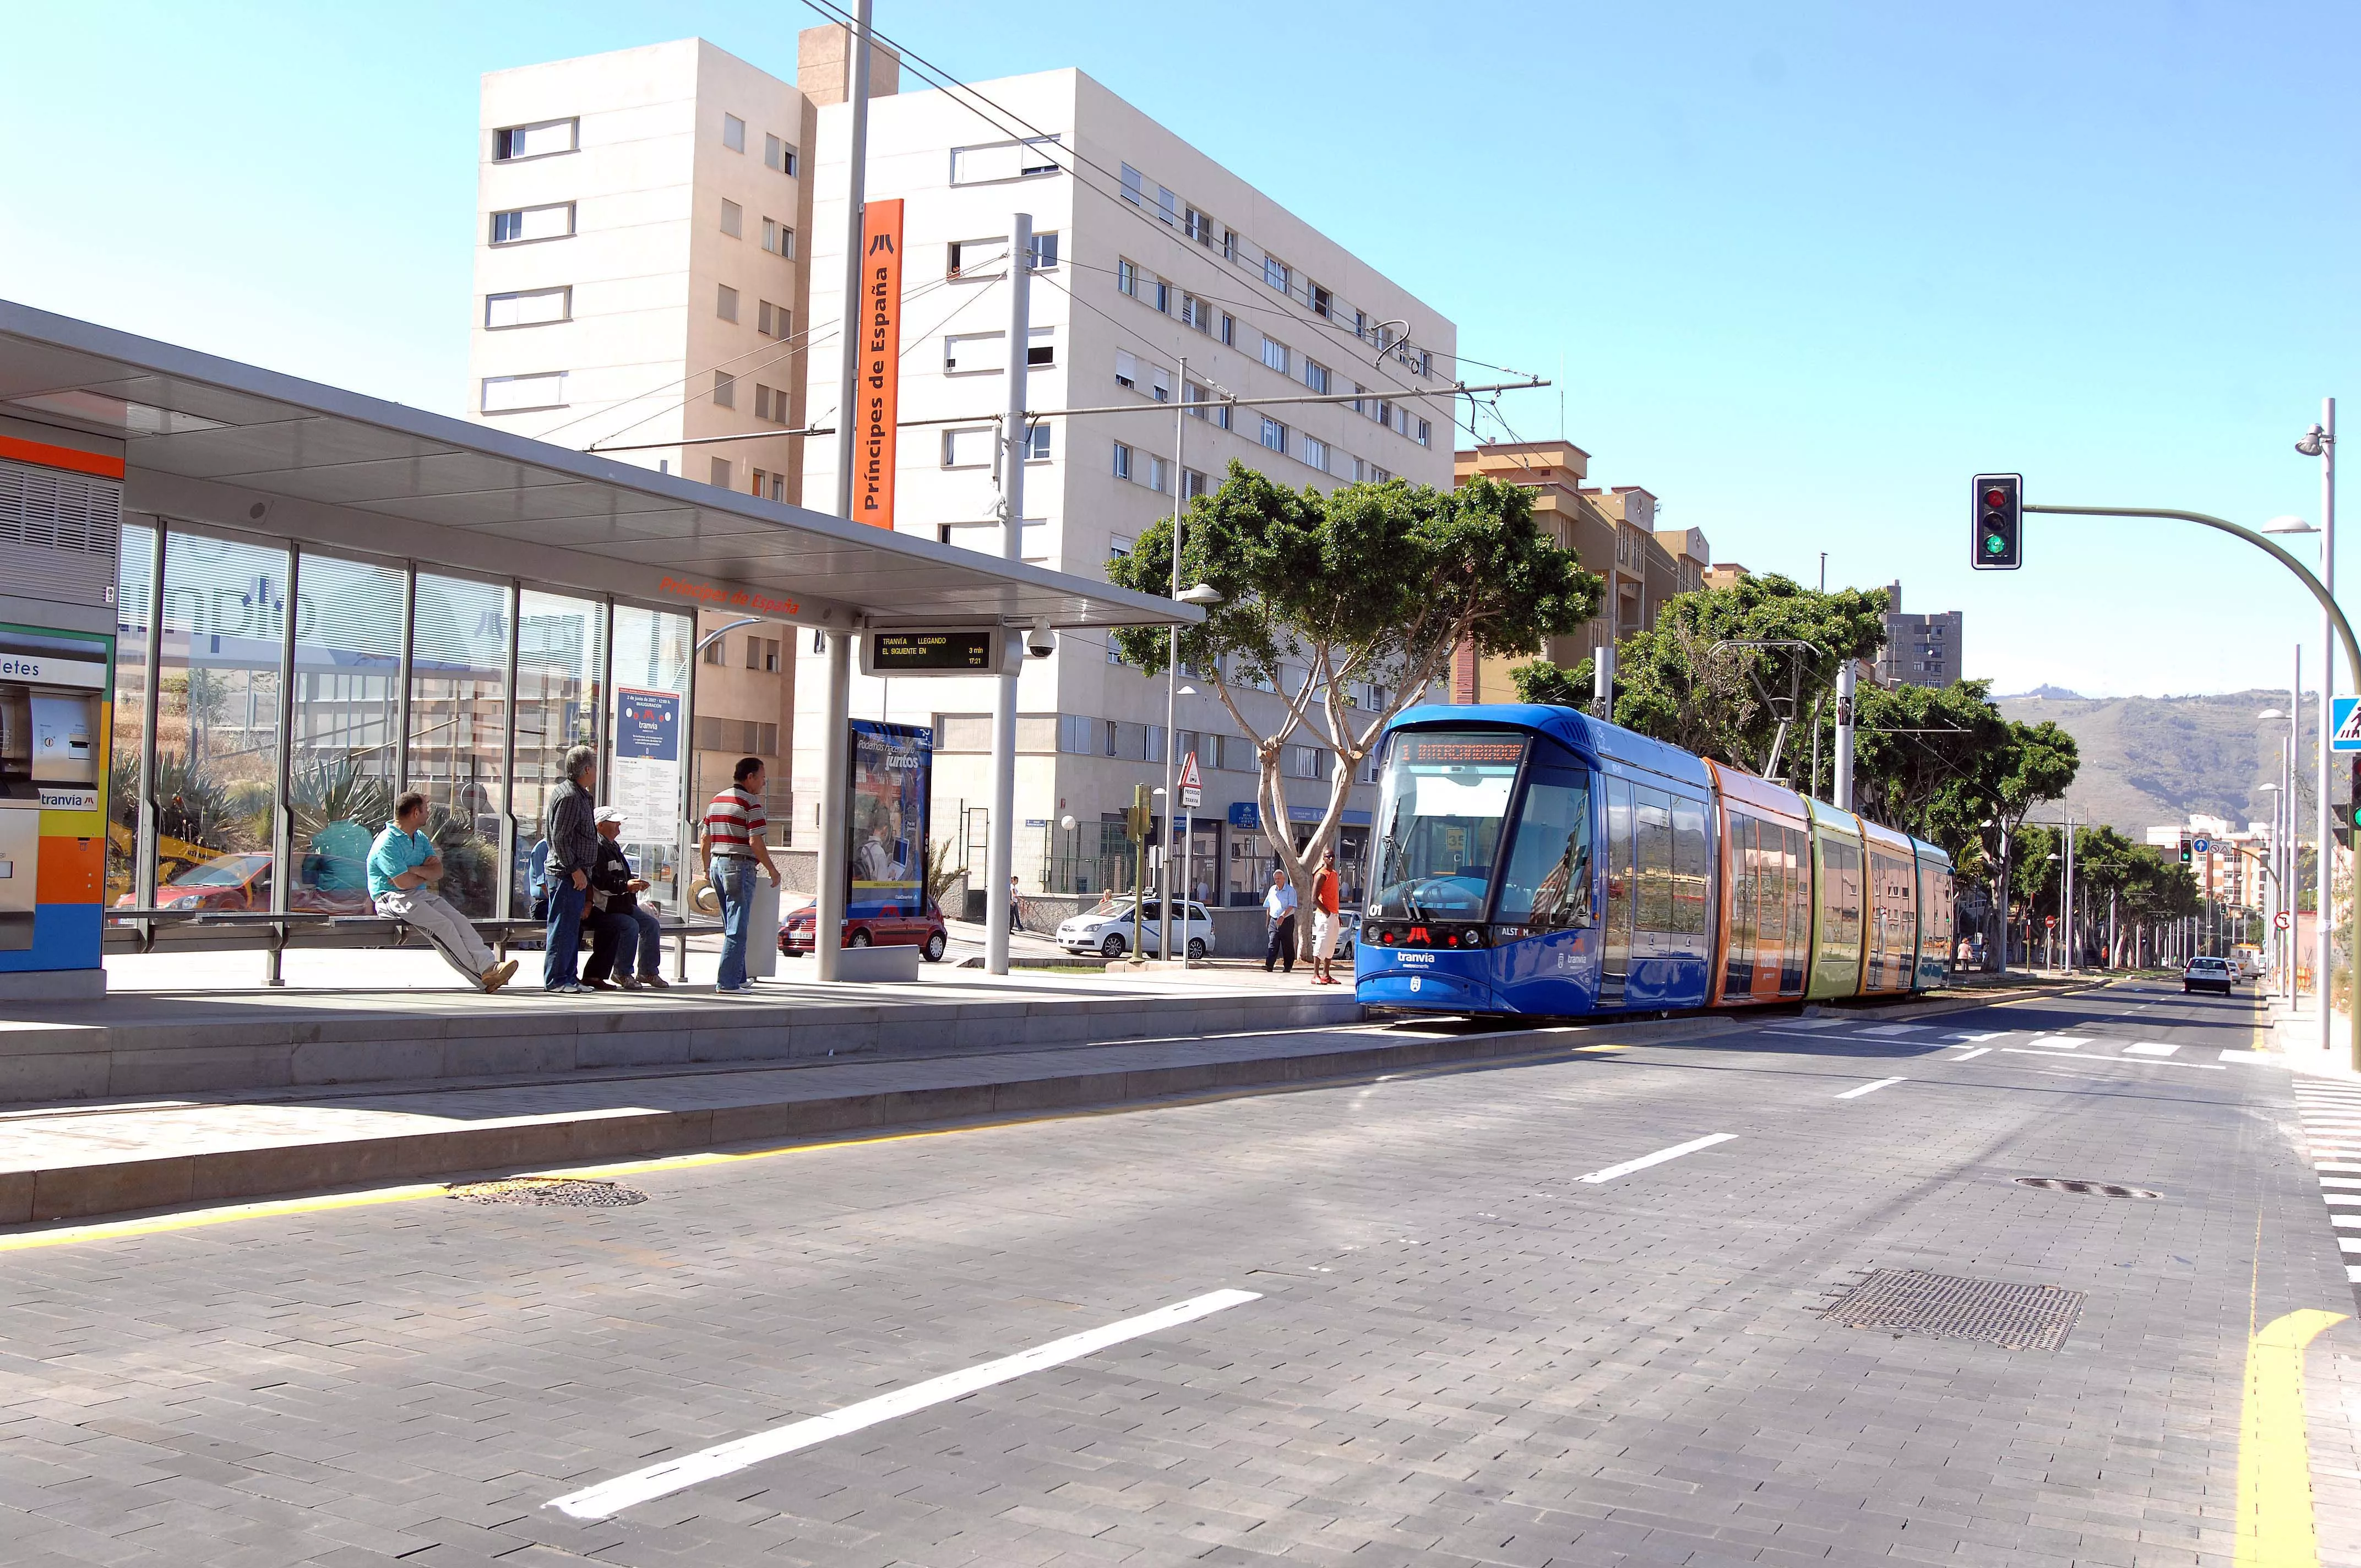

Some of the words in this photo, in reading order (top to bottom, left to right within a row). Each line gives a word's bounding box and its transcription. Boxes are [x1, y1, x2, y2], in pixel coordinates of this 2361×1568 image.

[871, 267, 889, 352] España
[868, 361, 884, 389] de
[864, 397, 885, 510] Príncipes
[659, 576, 729, 603] Príncipes
[731, 589, 749, 605] de
[751, 594, 800, 615] España
[858, 740, 885, 752] Podemos
[1418, 744, 1524, 760] INTERCAMBIADOR
[885, 752, 918, 771] juntos
[1369, 904, 1383, 917] 01
[1502, 927, 1528, 936] ALSTOM
